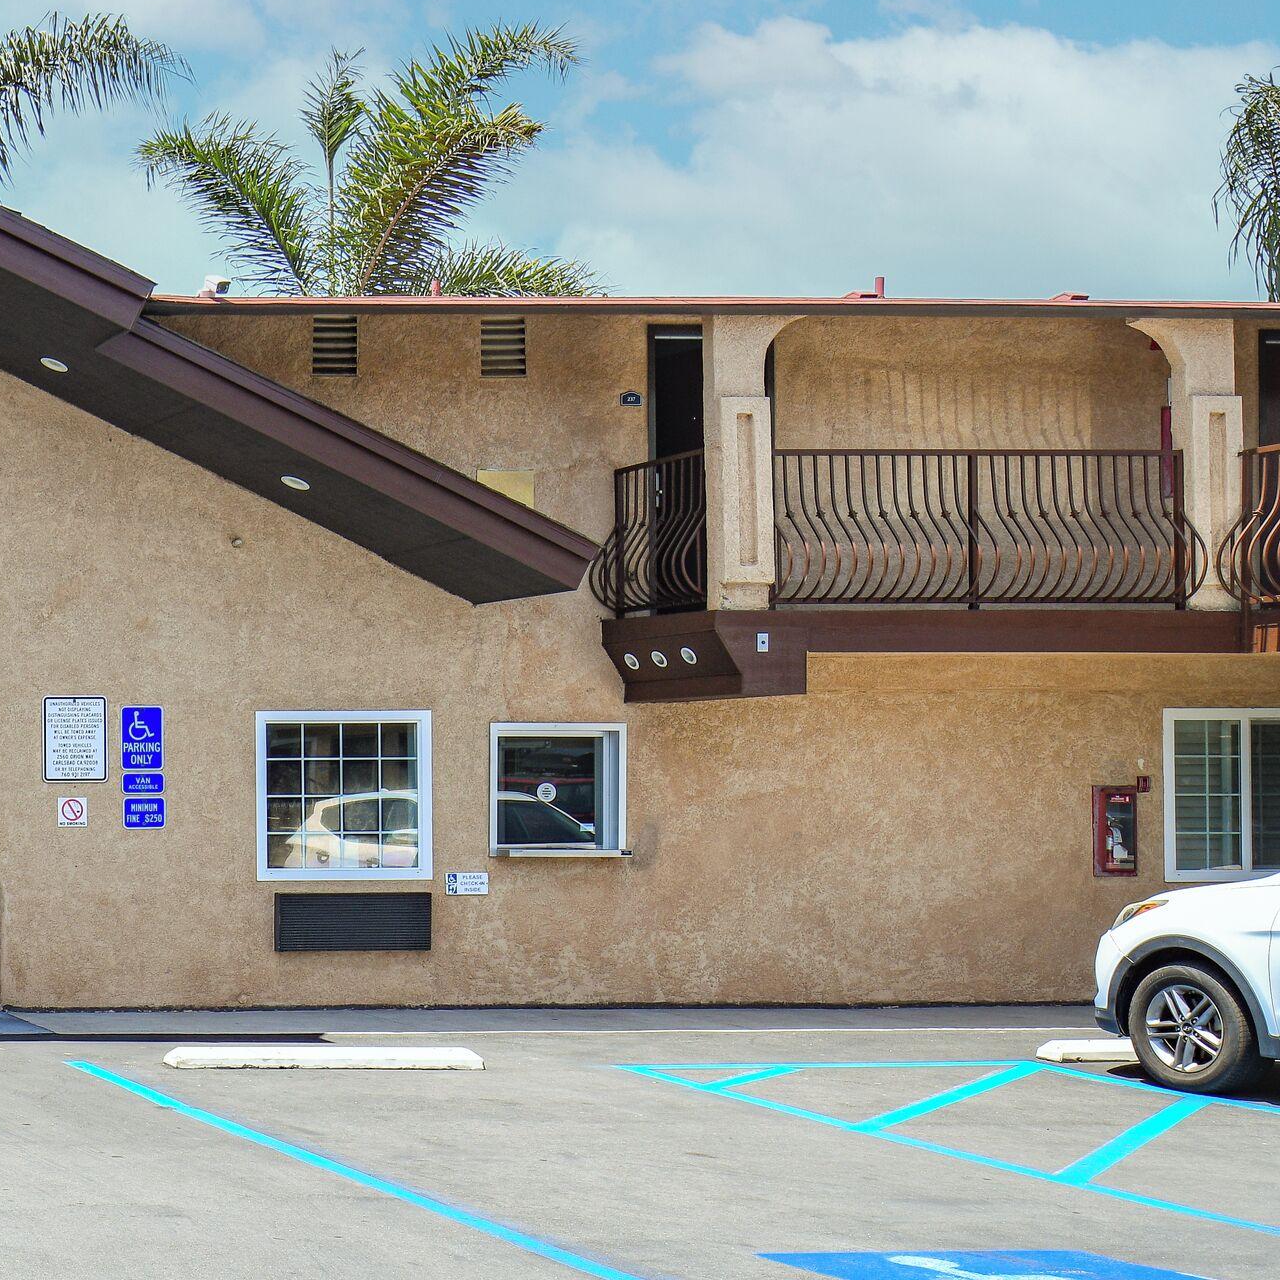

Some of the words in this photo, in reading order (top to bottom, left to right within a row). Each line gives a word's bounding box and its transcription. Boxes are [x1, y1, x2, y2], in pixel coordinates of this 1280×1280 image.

[123, 742, 160, 752] PARKING
[130, 754, 153, 764] ONLY
[130, 804, 158, 812] MINIMUM
[126, 814, 140, 822] FINE
[144, 814, 162, 822] $250
